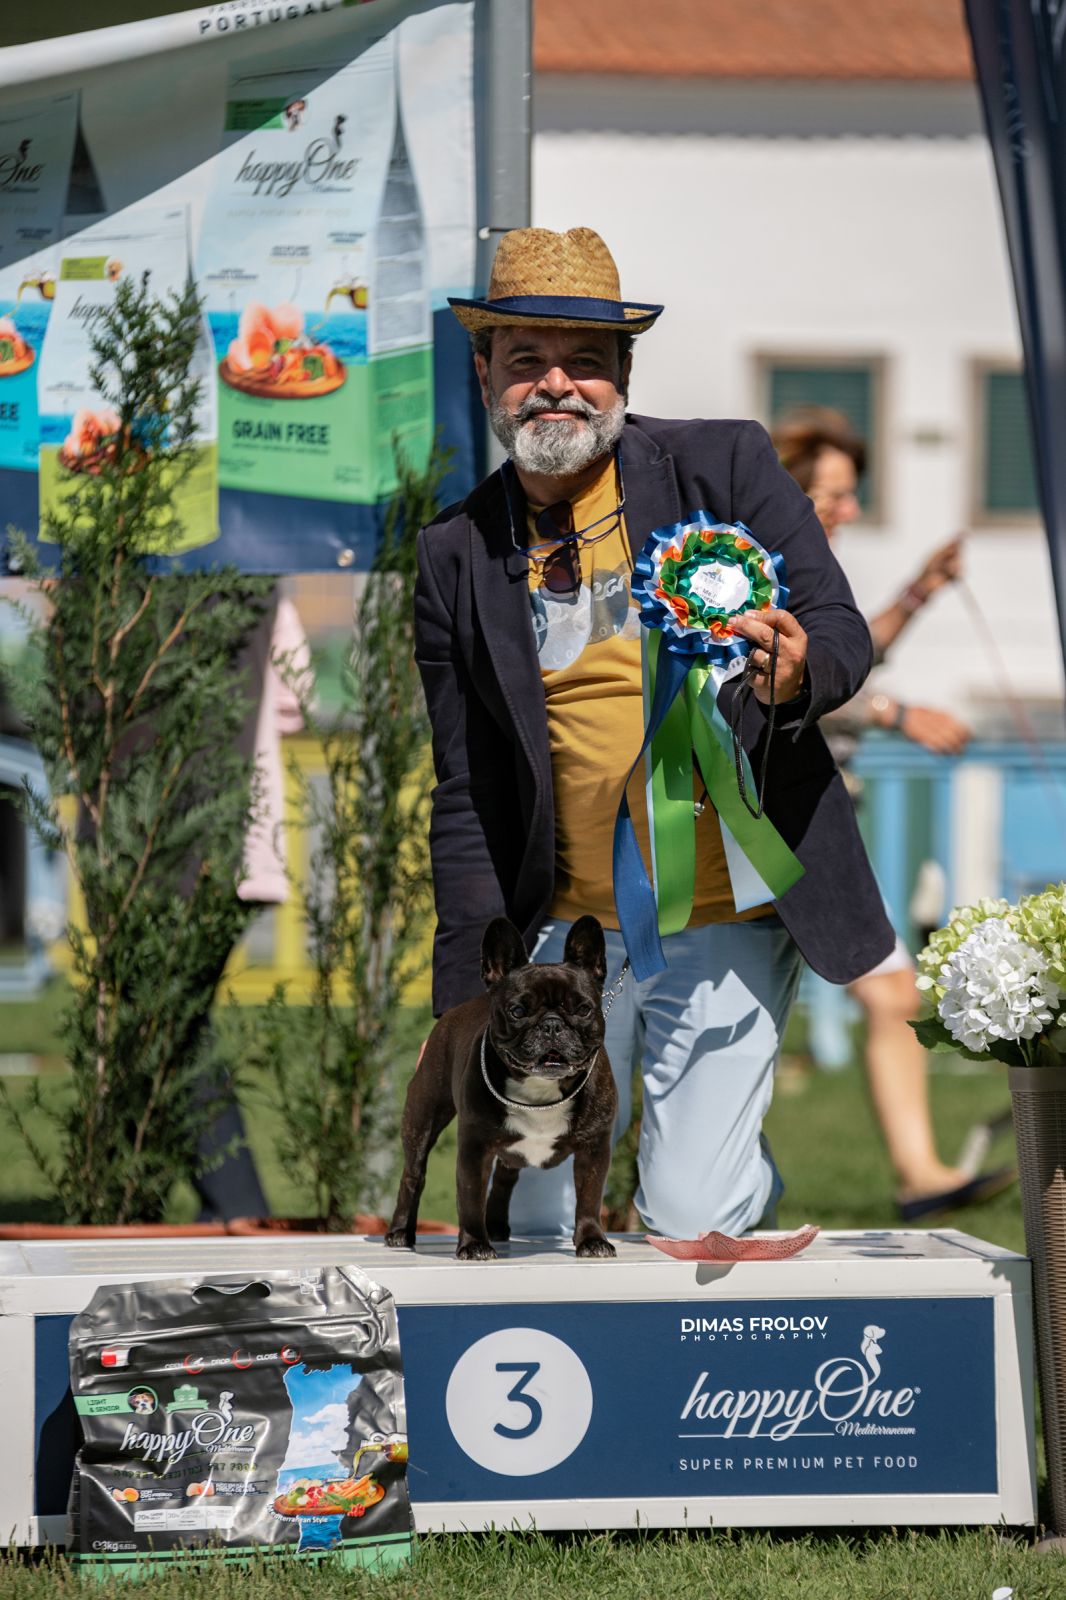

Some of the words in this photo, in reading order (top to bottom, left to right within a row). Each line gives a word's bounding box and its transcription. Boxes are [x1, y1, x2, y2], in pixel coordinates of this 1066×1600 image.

[200, 0, 334, 34] PORTUGAL
[233, 419, 281, 441] GRAIN
[287, 423, 330, 445] FREE
[256, 1353, 278, 1361] CLOSE
[95, 1405, 120, 1413] SENIOR
[493, 1362, 543, 1440] 3
[835, 1420, 917, 1437] Mediterraneum
[679, 1459, 734, 1471] SUPER
[744, 1457, 825, 1470] PREMIUM
[834, 1457, 864, 1468] PET
[874, 1456, 918, 1468] FOOD
[312, 1516, 329, 1524] Style
